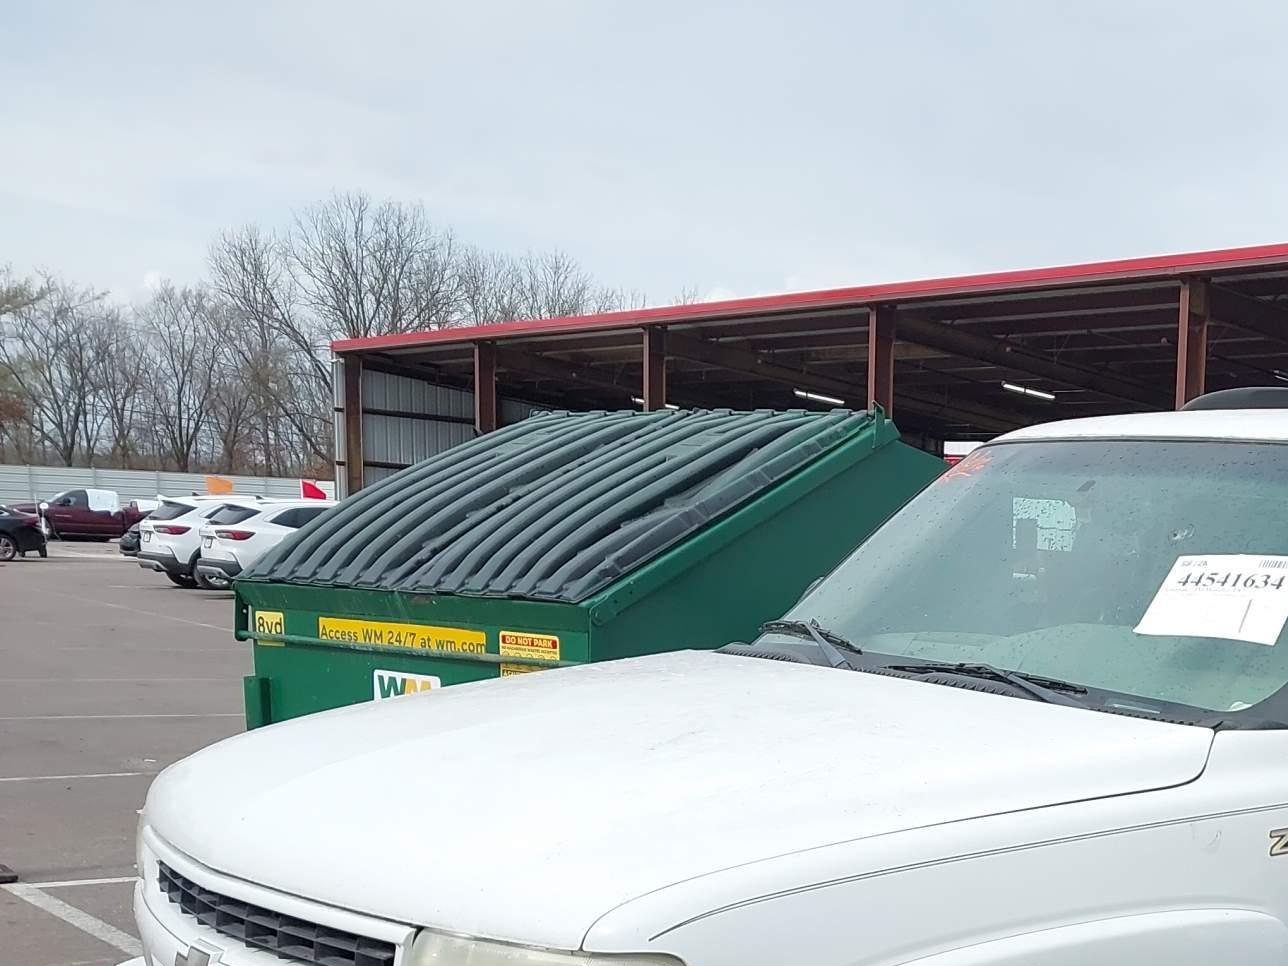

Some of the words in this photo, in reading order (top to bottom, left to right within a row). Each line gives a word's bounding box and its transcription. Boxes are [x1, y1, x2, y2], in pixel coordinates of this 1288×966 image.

[1177, 572, 1286, 590] 44541634
[320, 625, 358, 641] Access
[361, 628, 383, 644] WM
[387, 630, 417, 647] 24/7
[420, 637, 431, 649] at
[435, 639, 485, 654] wm.com
[505, 635, 517, 644] DO
[517, 637, 532, 646] NOT
[533, 639, 553, 649] PARK
